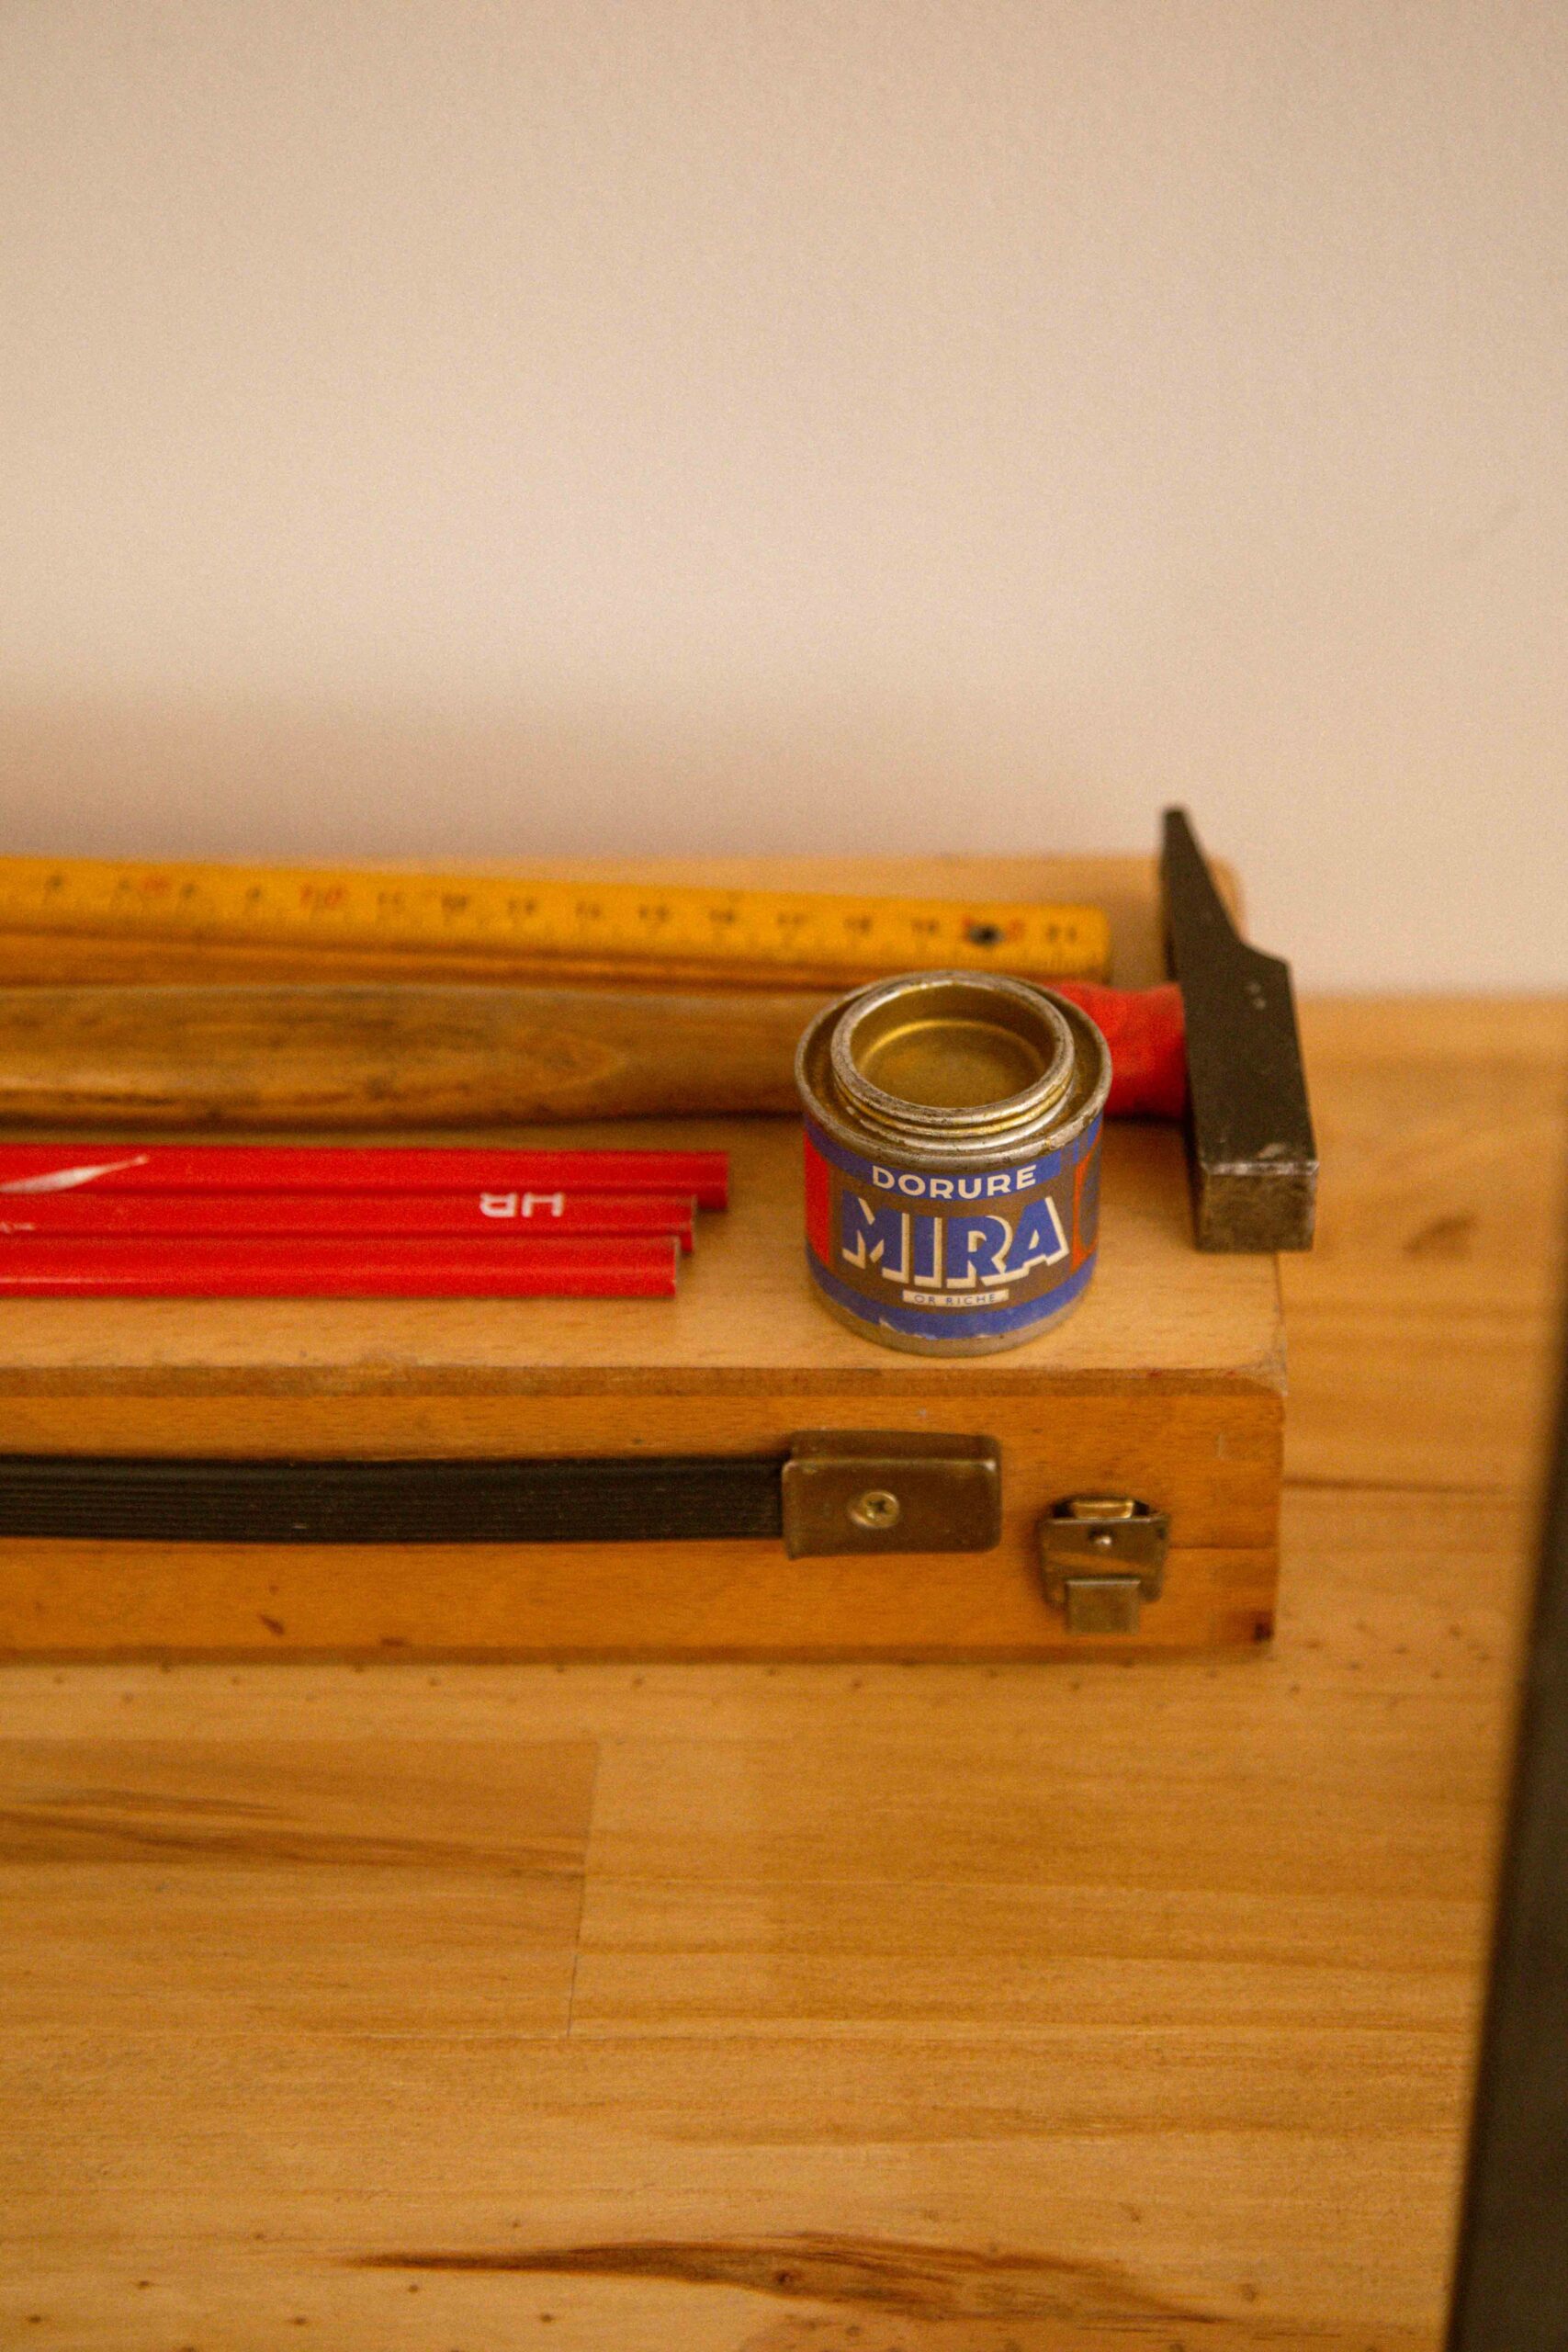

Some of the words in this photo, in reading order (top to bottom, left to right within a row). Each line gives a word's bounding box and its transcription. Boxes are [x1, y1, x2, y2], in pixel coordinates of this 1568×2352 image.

[872, 1164, 1037, 1199] DORURE
[842, 1191, 1070, 1289] MIRA
[914, 1294, 935, 1306] OR
[946, 1293, 997, 1306] RICHE
